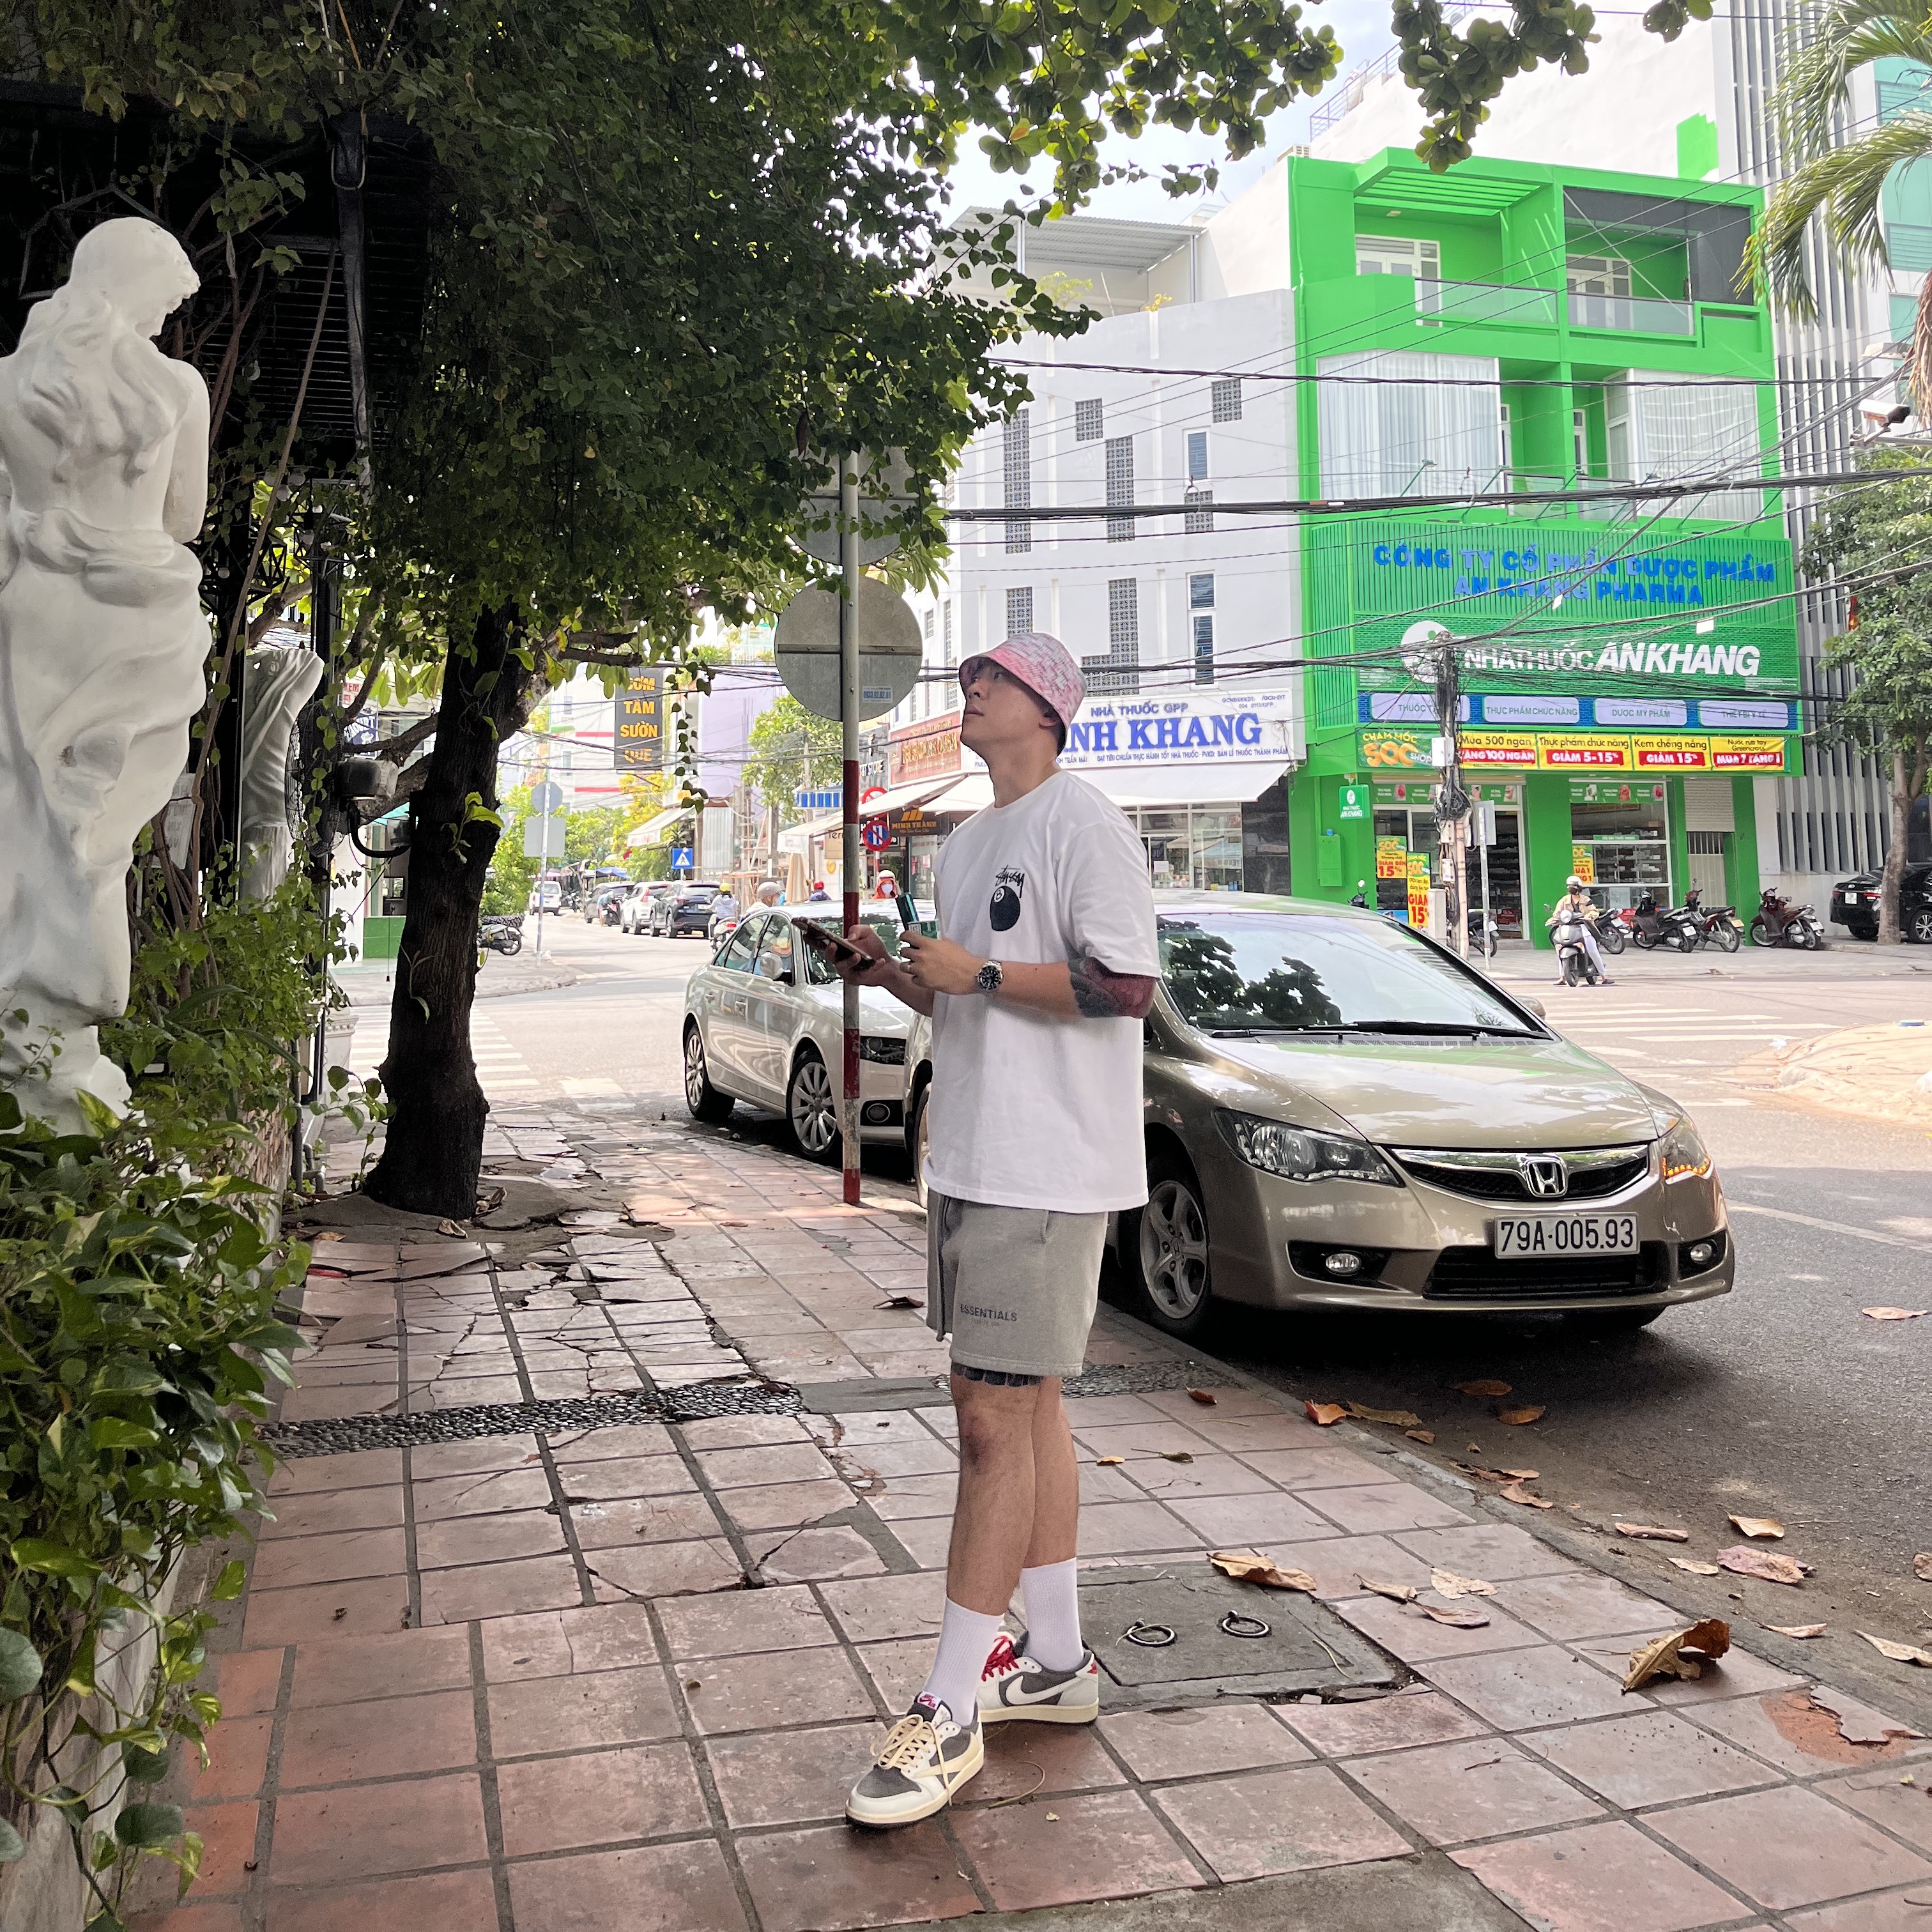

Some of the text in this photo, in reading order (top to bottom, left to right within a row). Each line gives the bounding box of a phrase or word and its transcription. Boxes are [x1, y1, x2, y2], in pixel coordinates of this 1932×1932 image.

[1374, 542, 1452, 569] CÔNG
[1459, 548, 1493, 570] TY
[1704, 553, 1775, 582] PHẨM
[1454, 576, 1703, 604] AN KHANG PHARMA
[1091, 701, 1189, 717] NHÀ THUỐC GPP
[1063, 713, 1262, 753] NH KHANG
[1462, 735, 1482, 745] Mua
[1485, 736, 1504, 746] 500
[1634, 739, 1653, 747] Kem
[1485, 749, 1506, 760] 100
[960, 1304, 1018, 1322] ESSENTIALS
